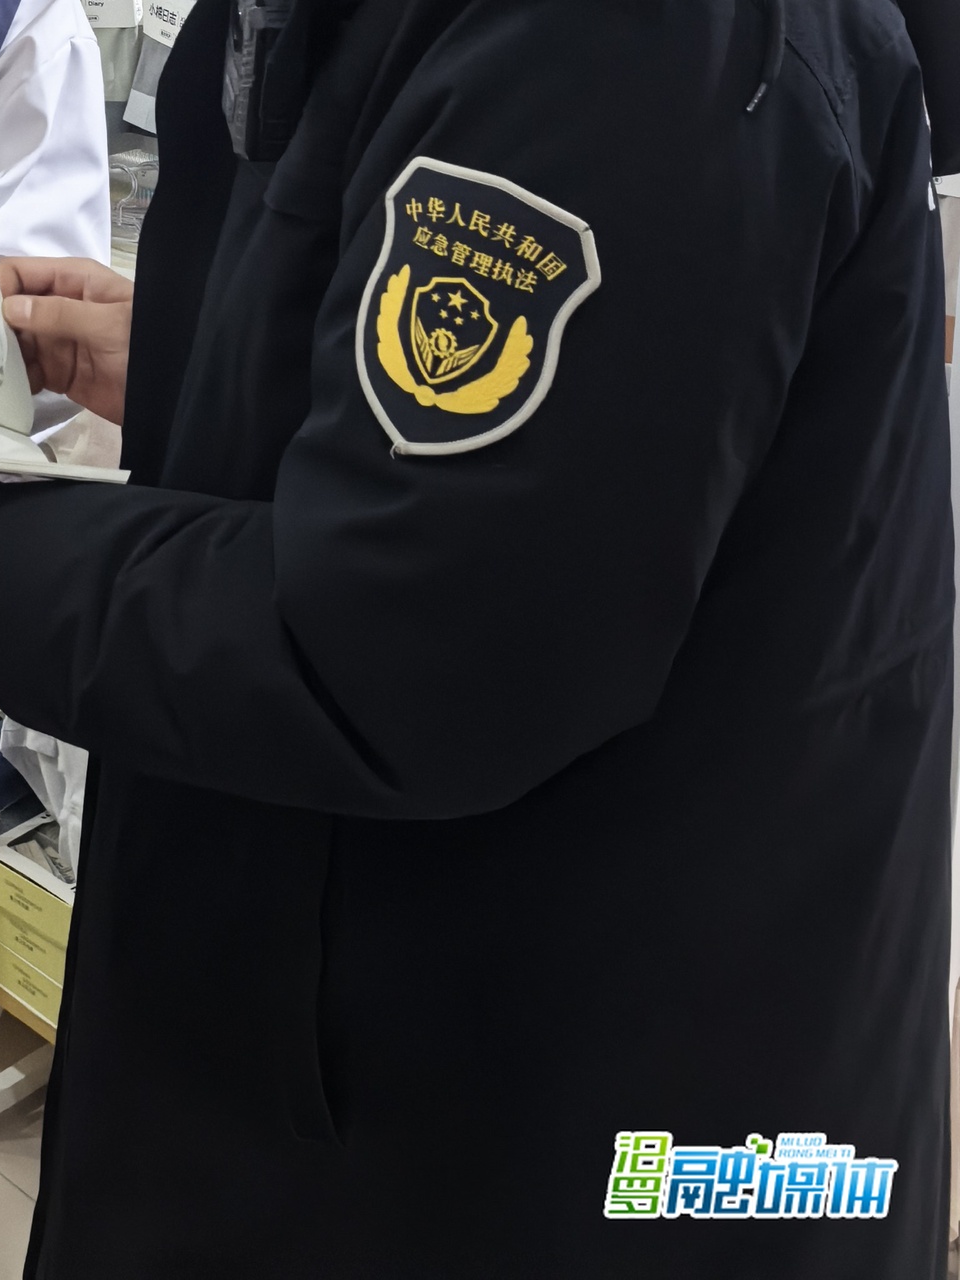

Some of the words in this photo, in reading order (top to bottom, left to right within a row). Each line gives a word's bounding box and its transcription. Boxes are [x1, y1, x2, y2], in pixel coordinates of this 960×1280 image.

[405, 197, 567, 281] 中华人民共和国
[412, 226, 538, 293] 应急管理执法
